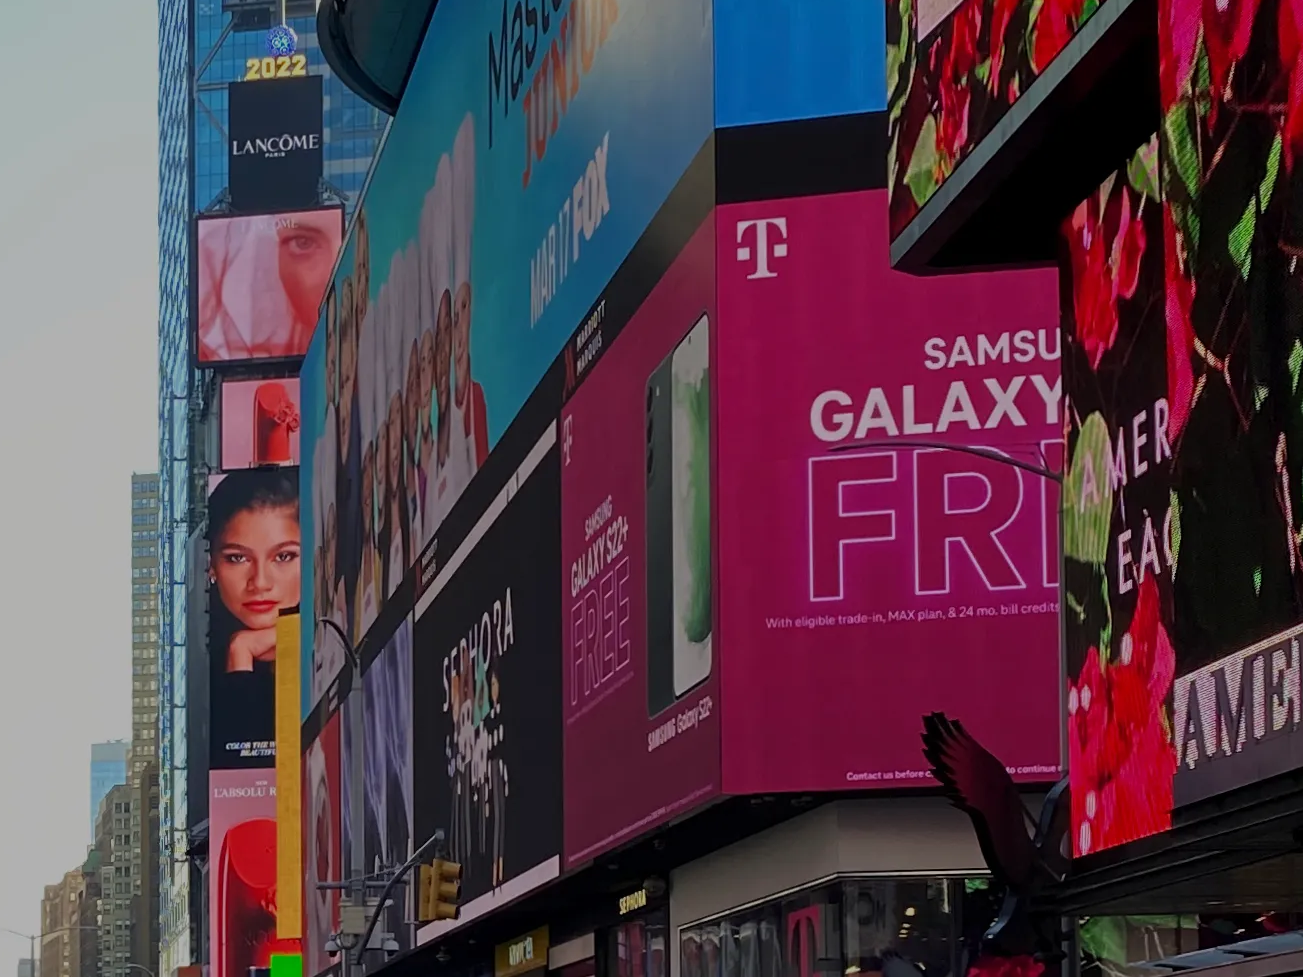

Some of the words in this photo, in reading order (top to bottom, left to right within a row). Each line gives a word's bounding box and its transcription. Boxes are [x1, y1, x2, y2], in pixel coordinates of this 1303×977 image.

[245, 54, 308, 81] 2022
[232, 133, 320, 156] LANCÔME
[572, 130, 611, 264] FOX
[809, 374, 1063, 443] GALAXY
[584, 494, 613, 542] SAMSUNG
[571, 532, 606, 598] GALAXY
[606, 515, 629, 564] S22+
[766, 617, 793, 629] With
[794, 614, 836, 629] eligible
[837, 612, 886, 625] trade-in,
[888, 609, 915, 622] MAX
[917, 608, 946, 623] plan,
[947, 607, 957, 618] &
[959, 606, 974, 617] 24
[976, 607, 998, 617] mo.
[1000, 603, 1019, 615] bill
[1021, 601, 1060, 614] credits
[569, 555, 631, 708] FREE
[846, 771, 882, 782] Contact
[883, 772, 894, 780] us
[895, 770, 924, 779] before
[1017, 764, 1057, 774] continue
[619, 889, 647, 915] SEPHORA
